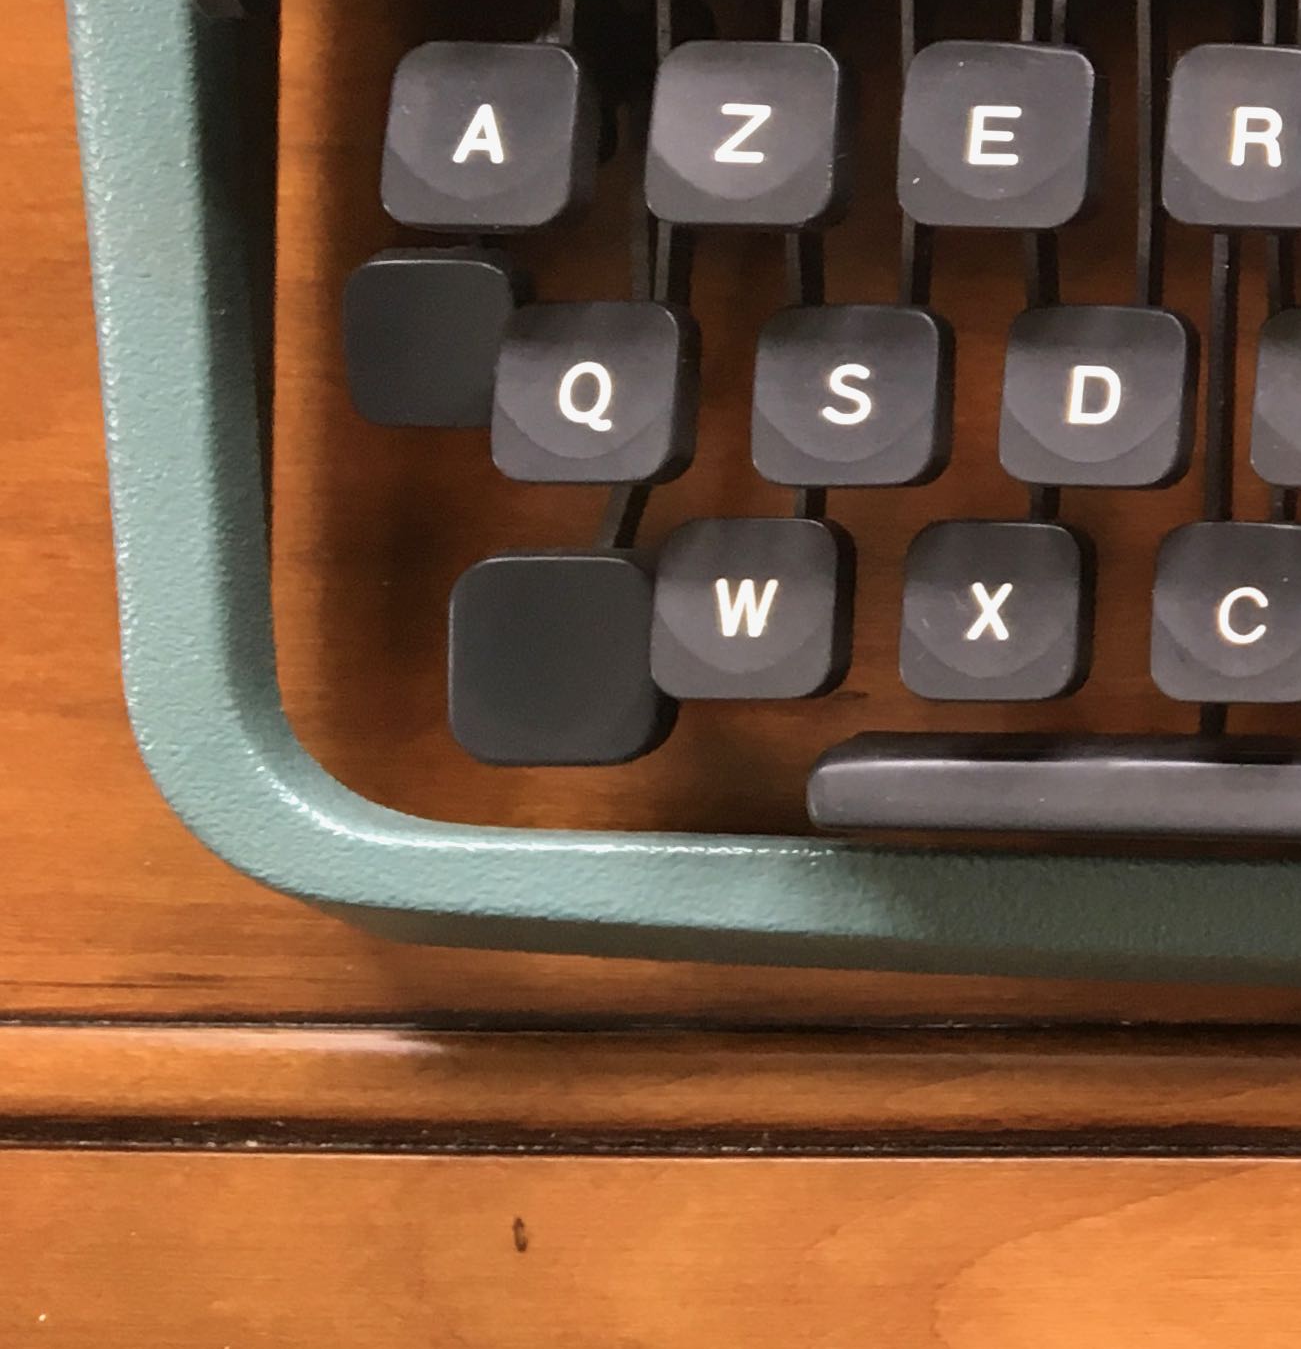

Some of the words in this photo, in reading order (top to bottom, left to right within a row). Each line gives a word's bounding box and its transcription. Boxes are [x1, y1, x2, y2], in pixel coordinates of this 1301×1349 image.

[452, 103, 505, 164] A
[713, 103, 772, 164] Z
[967, 105, 1022, 166] E
[1230, 106, 1283, 168] R
[558, 361, 613, 432] Q
[821, 363, 872, 425] S
[1067, 365, 1122, 425] D
[715, 578, 779, 638] W
[966, 582, 1013, 641] X
[1217, 586, 1269, 645] C
